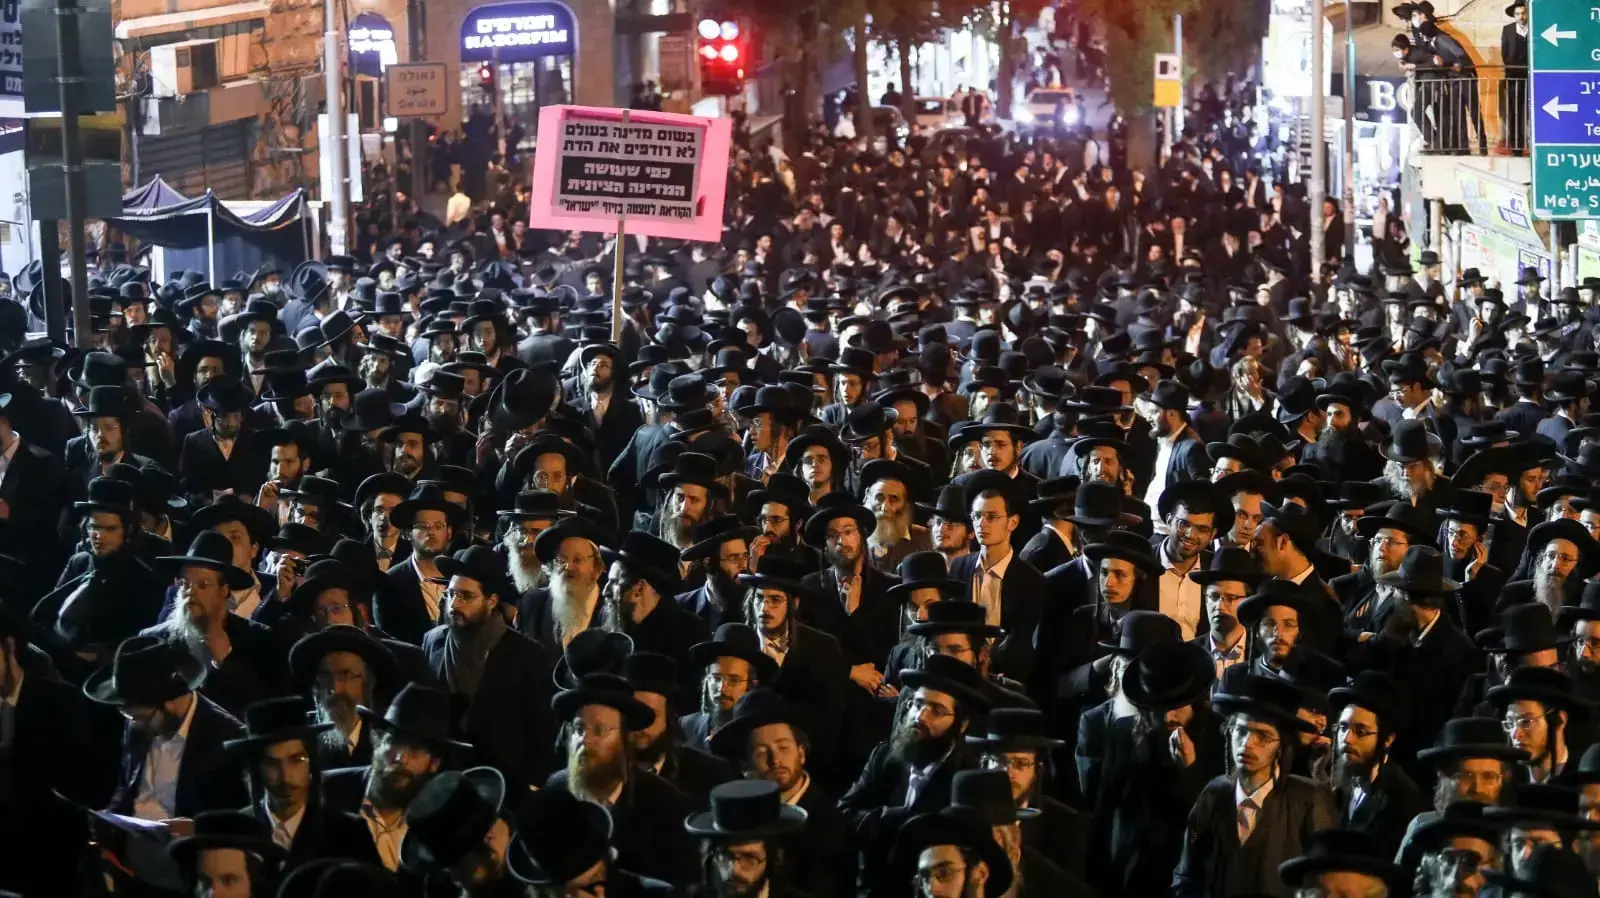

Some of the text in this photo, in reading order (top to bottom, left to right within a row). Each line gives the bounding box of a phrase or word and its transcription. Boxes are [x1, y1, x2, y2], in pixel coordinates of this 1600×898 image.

[565, 123, 695, 143] בשום מדינה בעולם
[563, 139, 696, 158] לא רודפים את הדת
[584, 162, 671, 179] כפי שעושה
[567, 178, 685, 197] המדינה הציונית
[626, 203, 656, 215] לעצמה
[1544, 194, 1579, 208] Me'a
[659, 205, 691, 219] הקוראת
